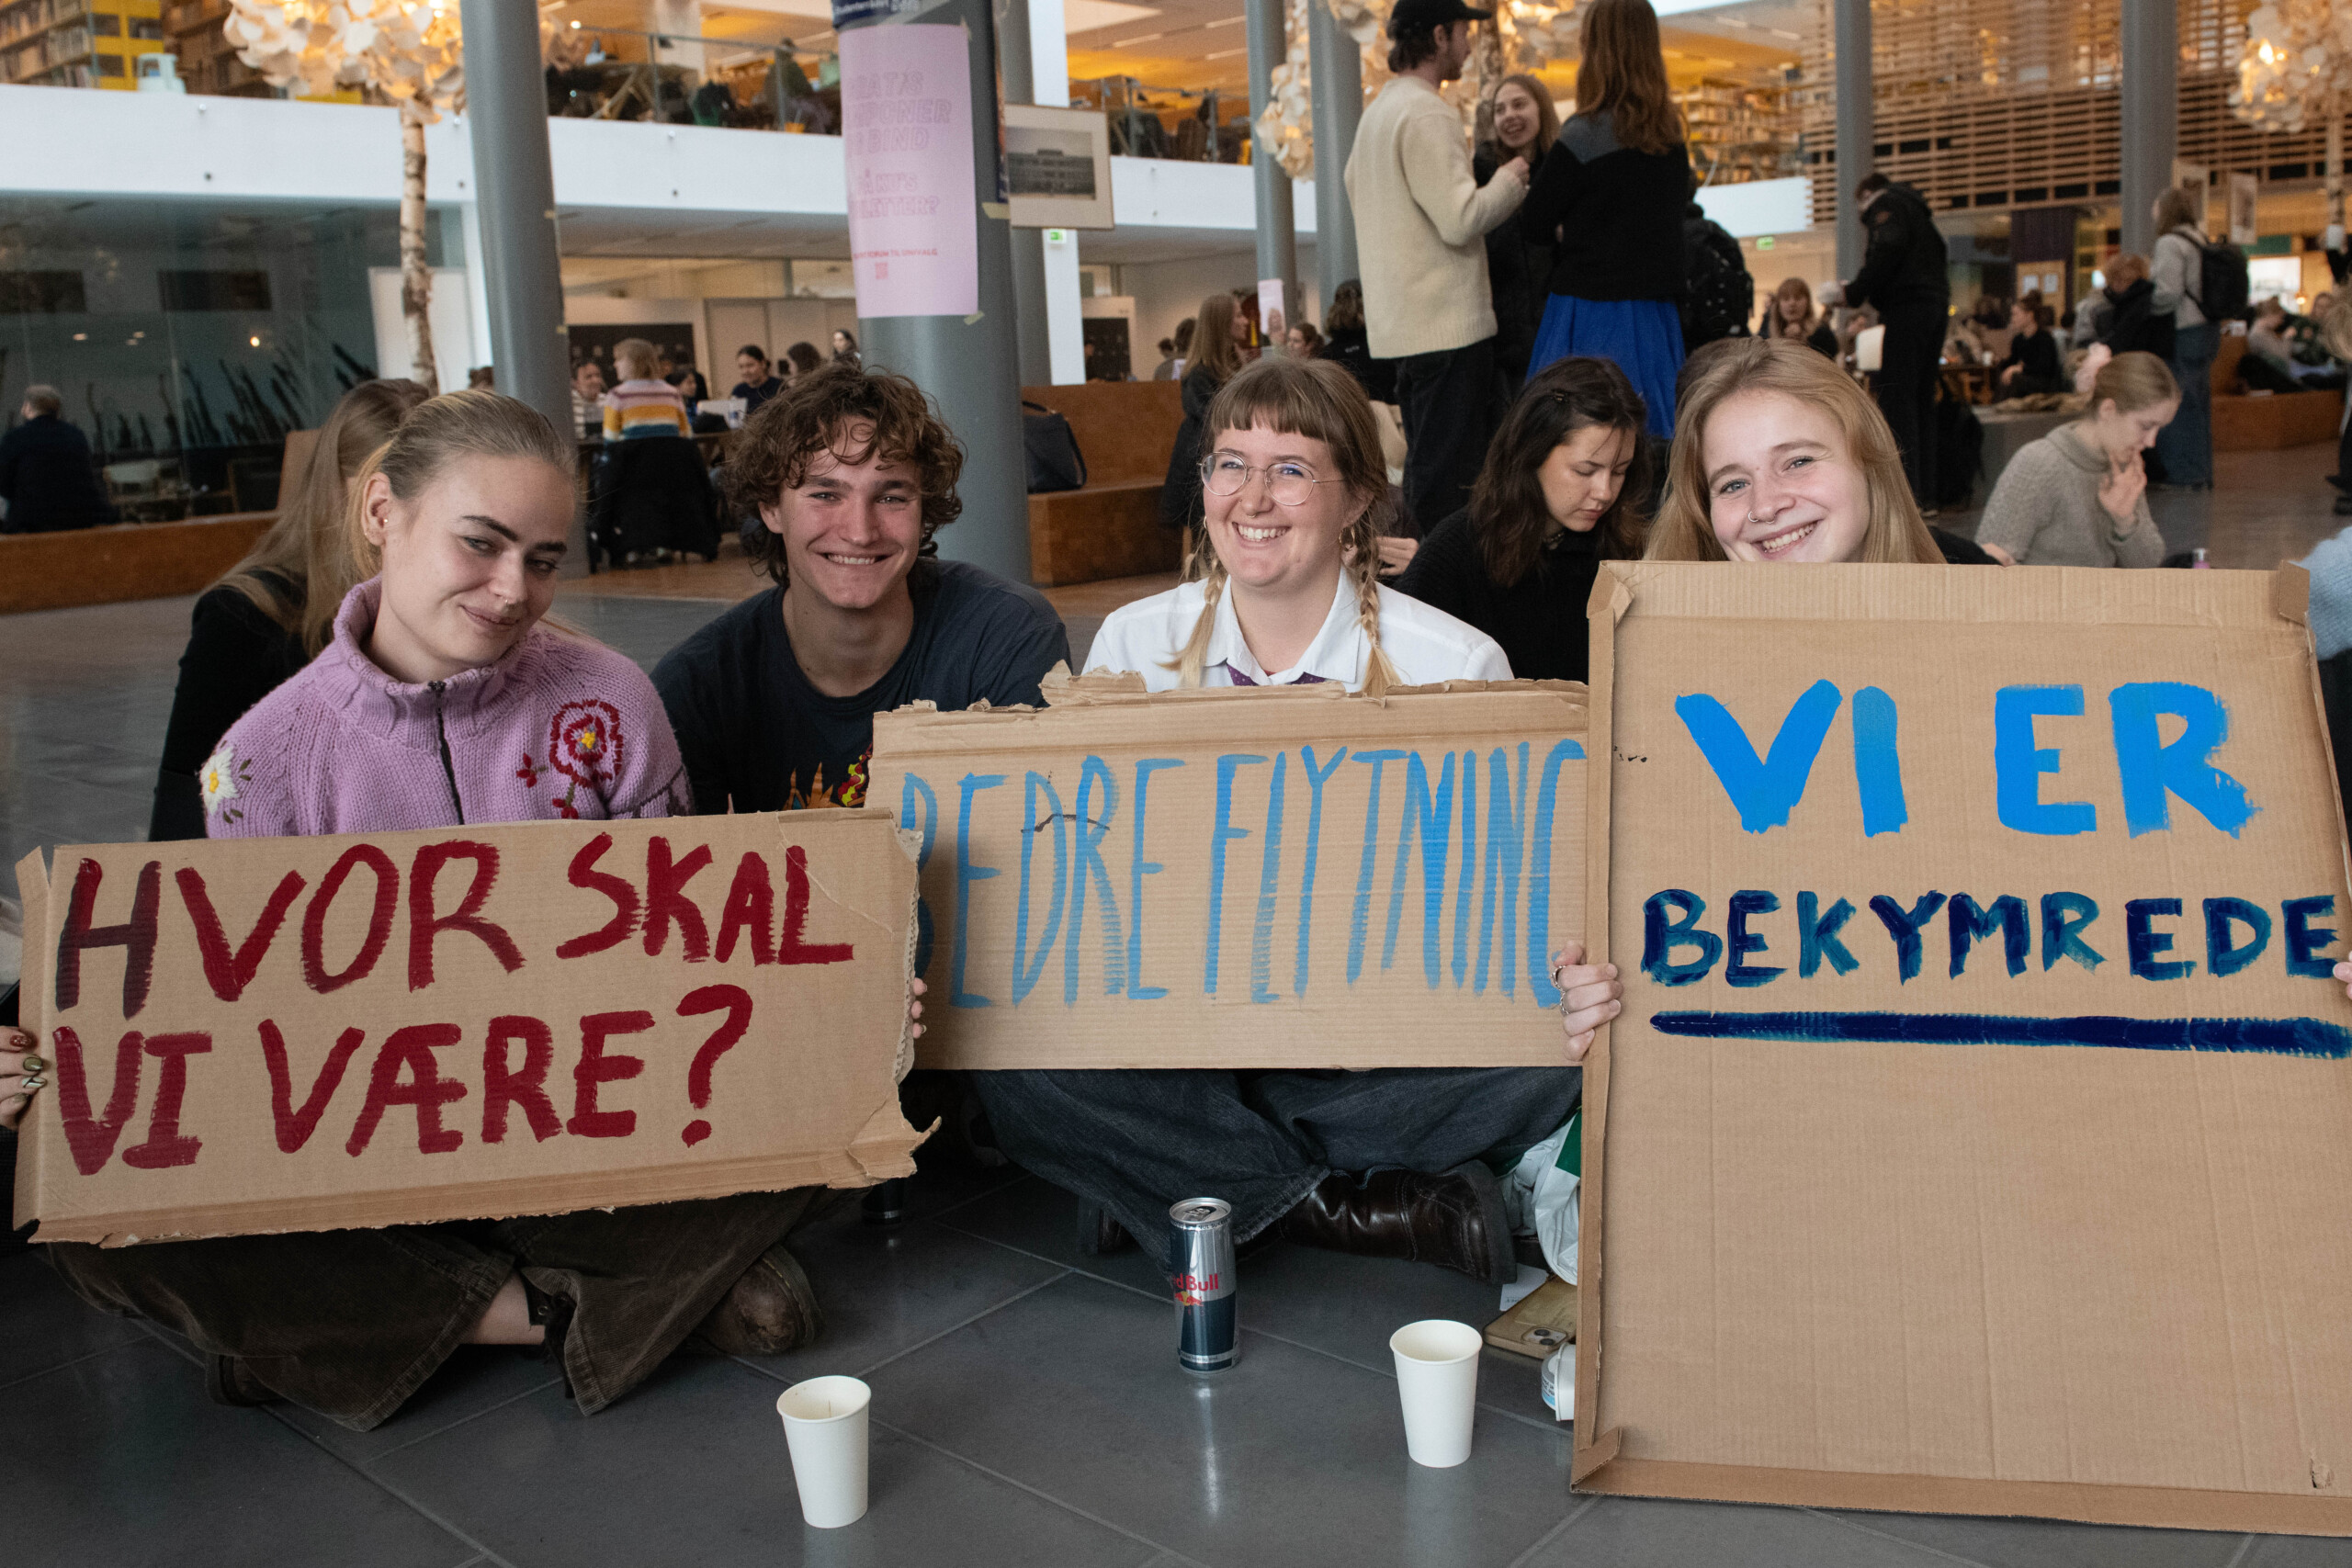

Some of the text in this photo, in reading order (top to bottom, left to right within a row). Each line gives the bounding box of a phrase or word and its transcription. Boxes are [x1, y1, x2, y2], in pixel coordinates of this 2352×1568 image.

[1675, 678, 2264, 840] VI ER
[57, 831, 854, 1020] HVOR SKAL
[902, 755, 1187, 1010] BEDRE
[1640, 887, 2340, 987] BEKYMREDE
[52, 984, 753, 1176] VI VÆRE?
[1185, 1273, 1218, 1292] Bull
